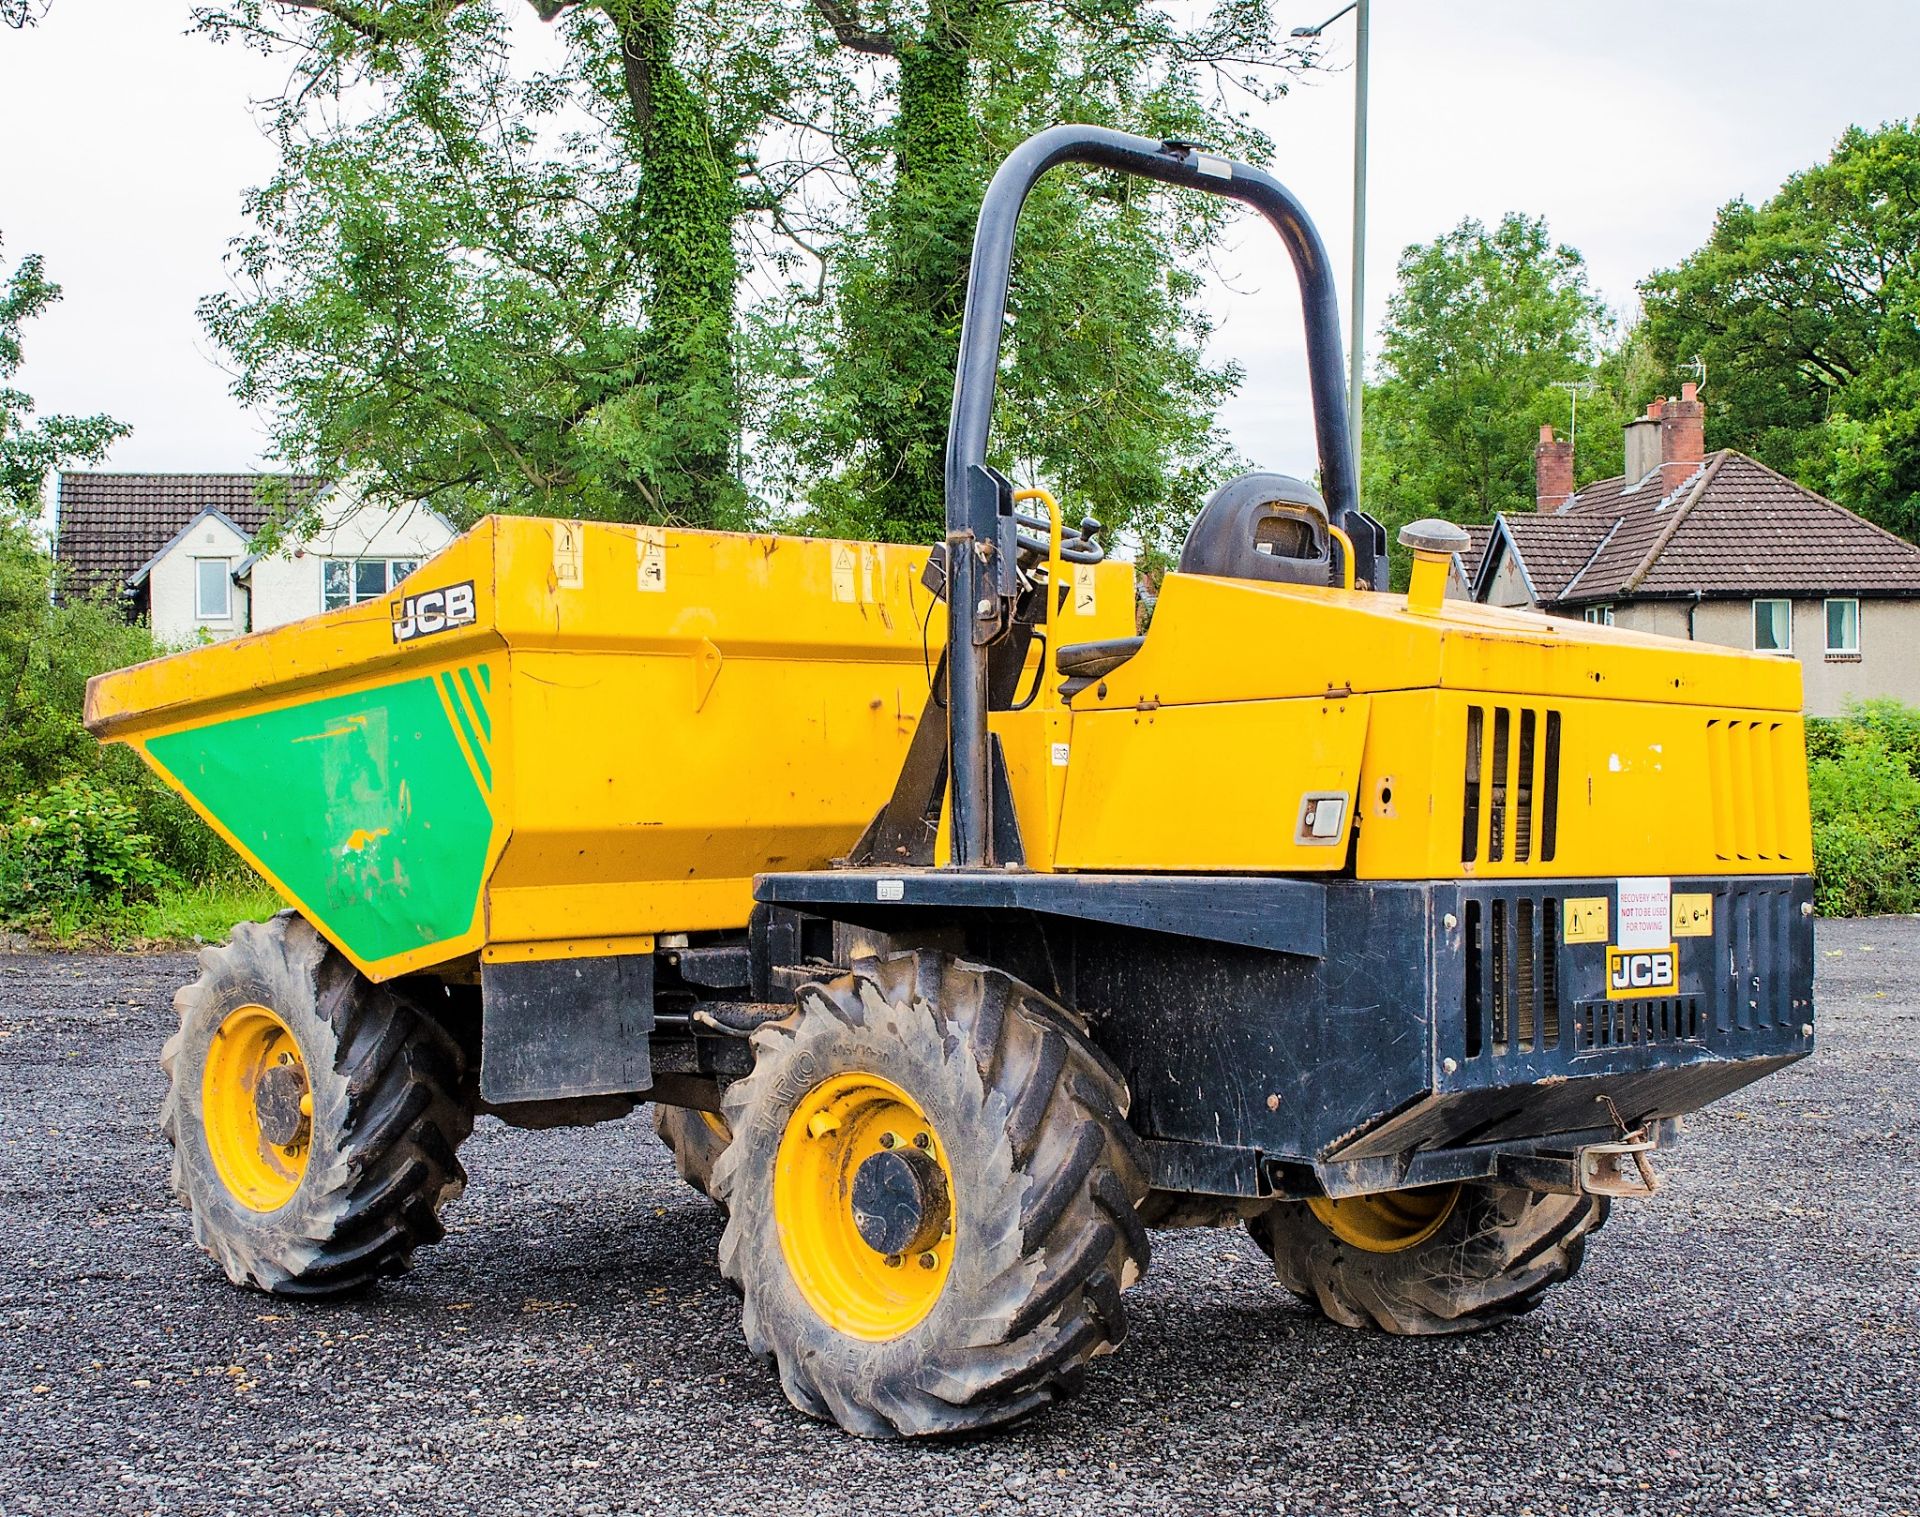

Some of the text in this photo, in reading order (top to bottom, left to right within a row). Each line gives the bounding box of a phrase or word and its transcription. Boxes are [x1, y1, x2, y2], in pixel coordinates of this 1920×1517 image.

[394, 585, 475, 639] JCB
[1621, 893, 1669, 902] RECOVERY HITCH
[1622, 907, 1668, 917] NOT TO BE USED
[1626, 922, 1662, 931] FOR TOWING
[1612, 954, 1673, 988] JCB
